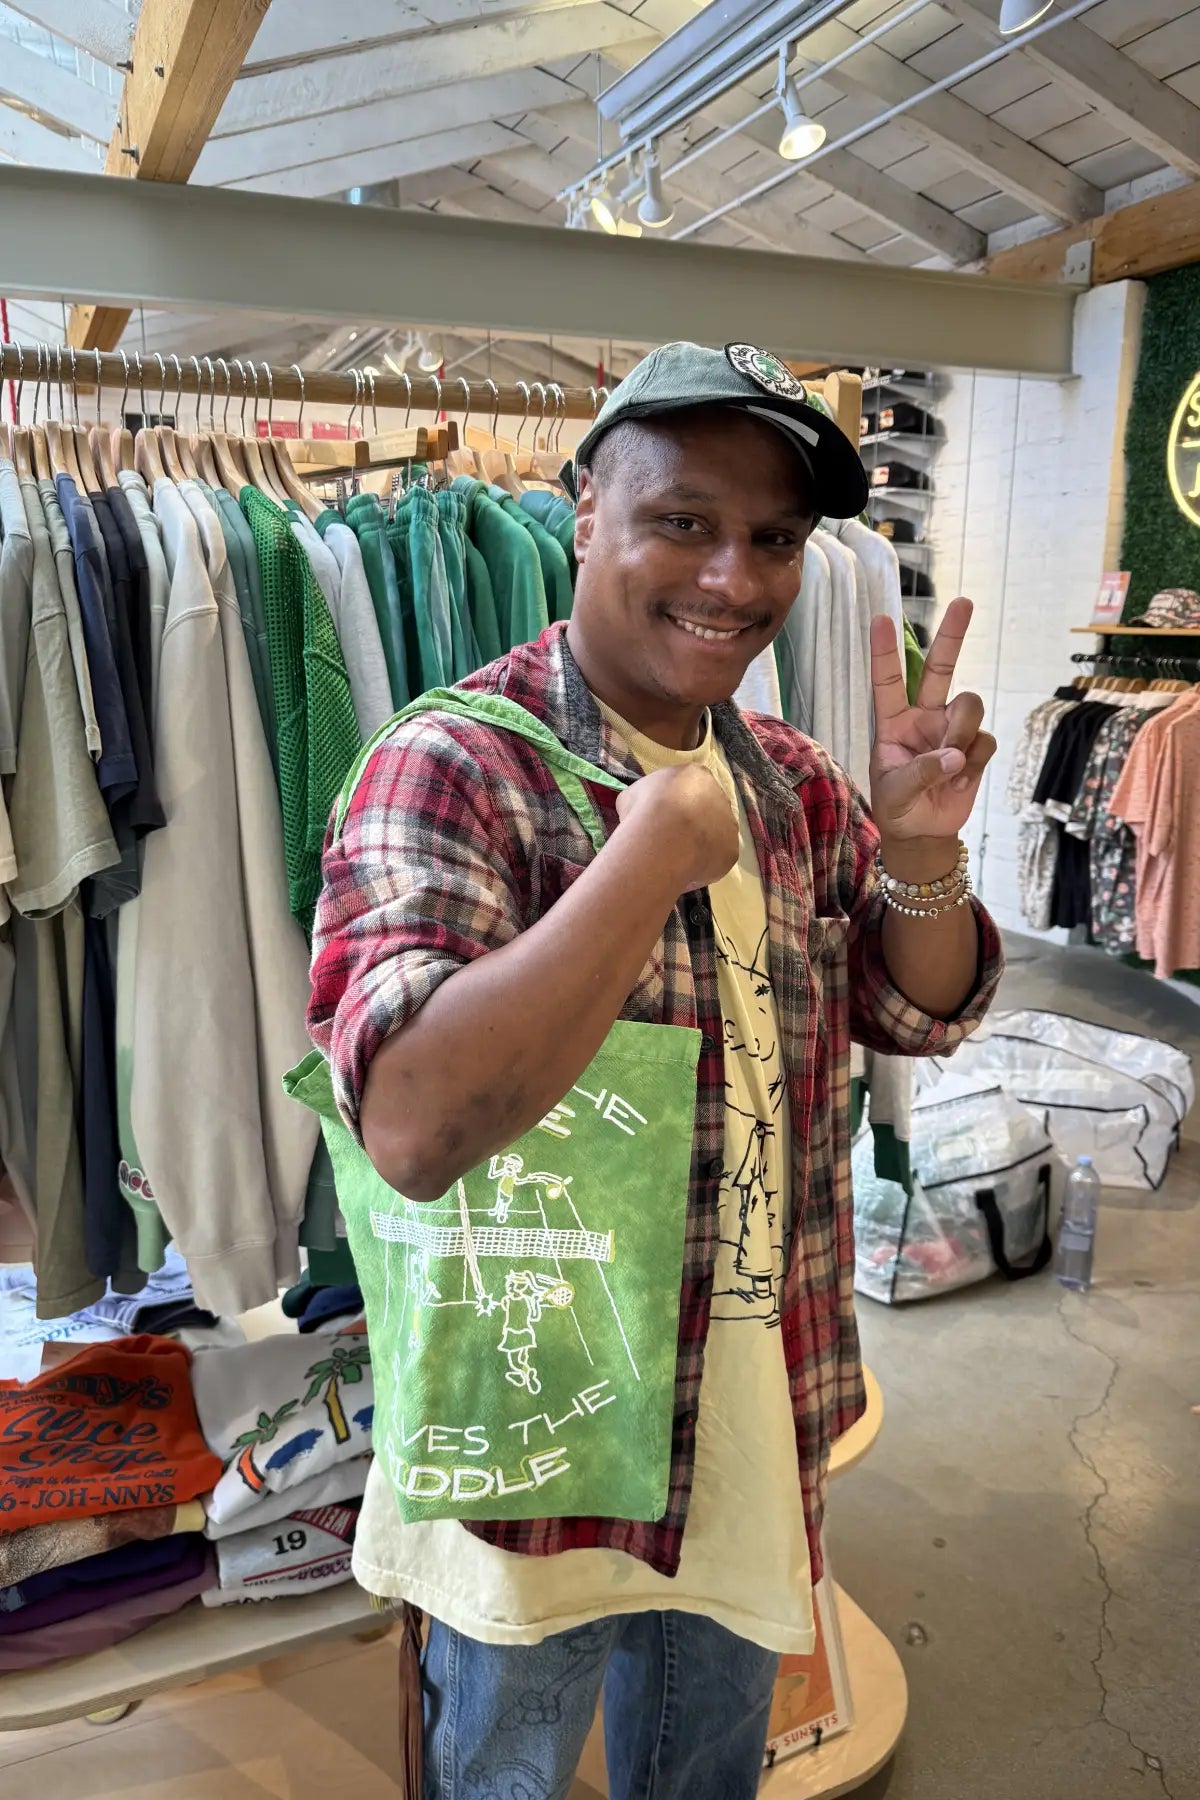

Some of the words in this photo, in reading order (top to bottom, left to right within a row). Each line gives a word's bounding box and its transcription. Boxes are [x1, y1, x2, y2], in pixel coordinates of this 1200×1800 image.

[573, 1085, 648, 1136] HE
[0, 1406, 161, 1446] Slice
[508, 1379, 617, 1445] THE
[2, 1443, 167, 1473] Shop
[272, 1529, 308, 1556] 19
